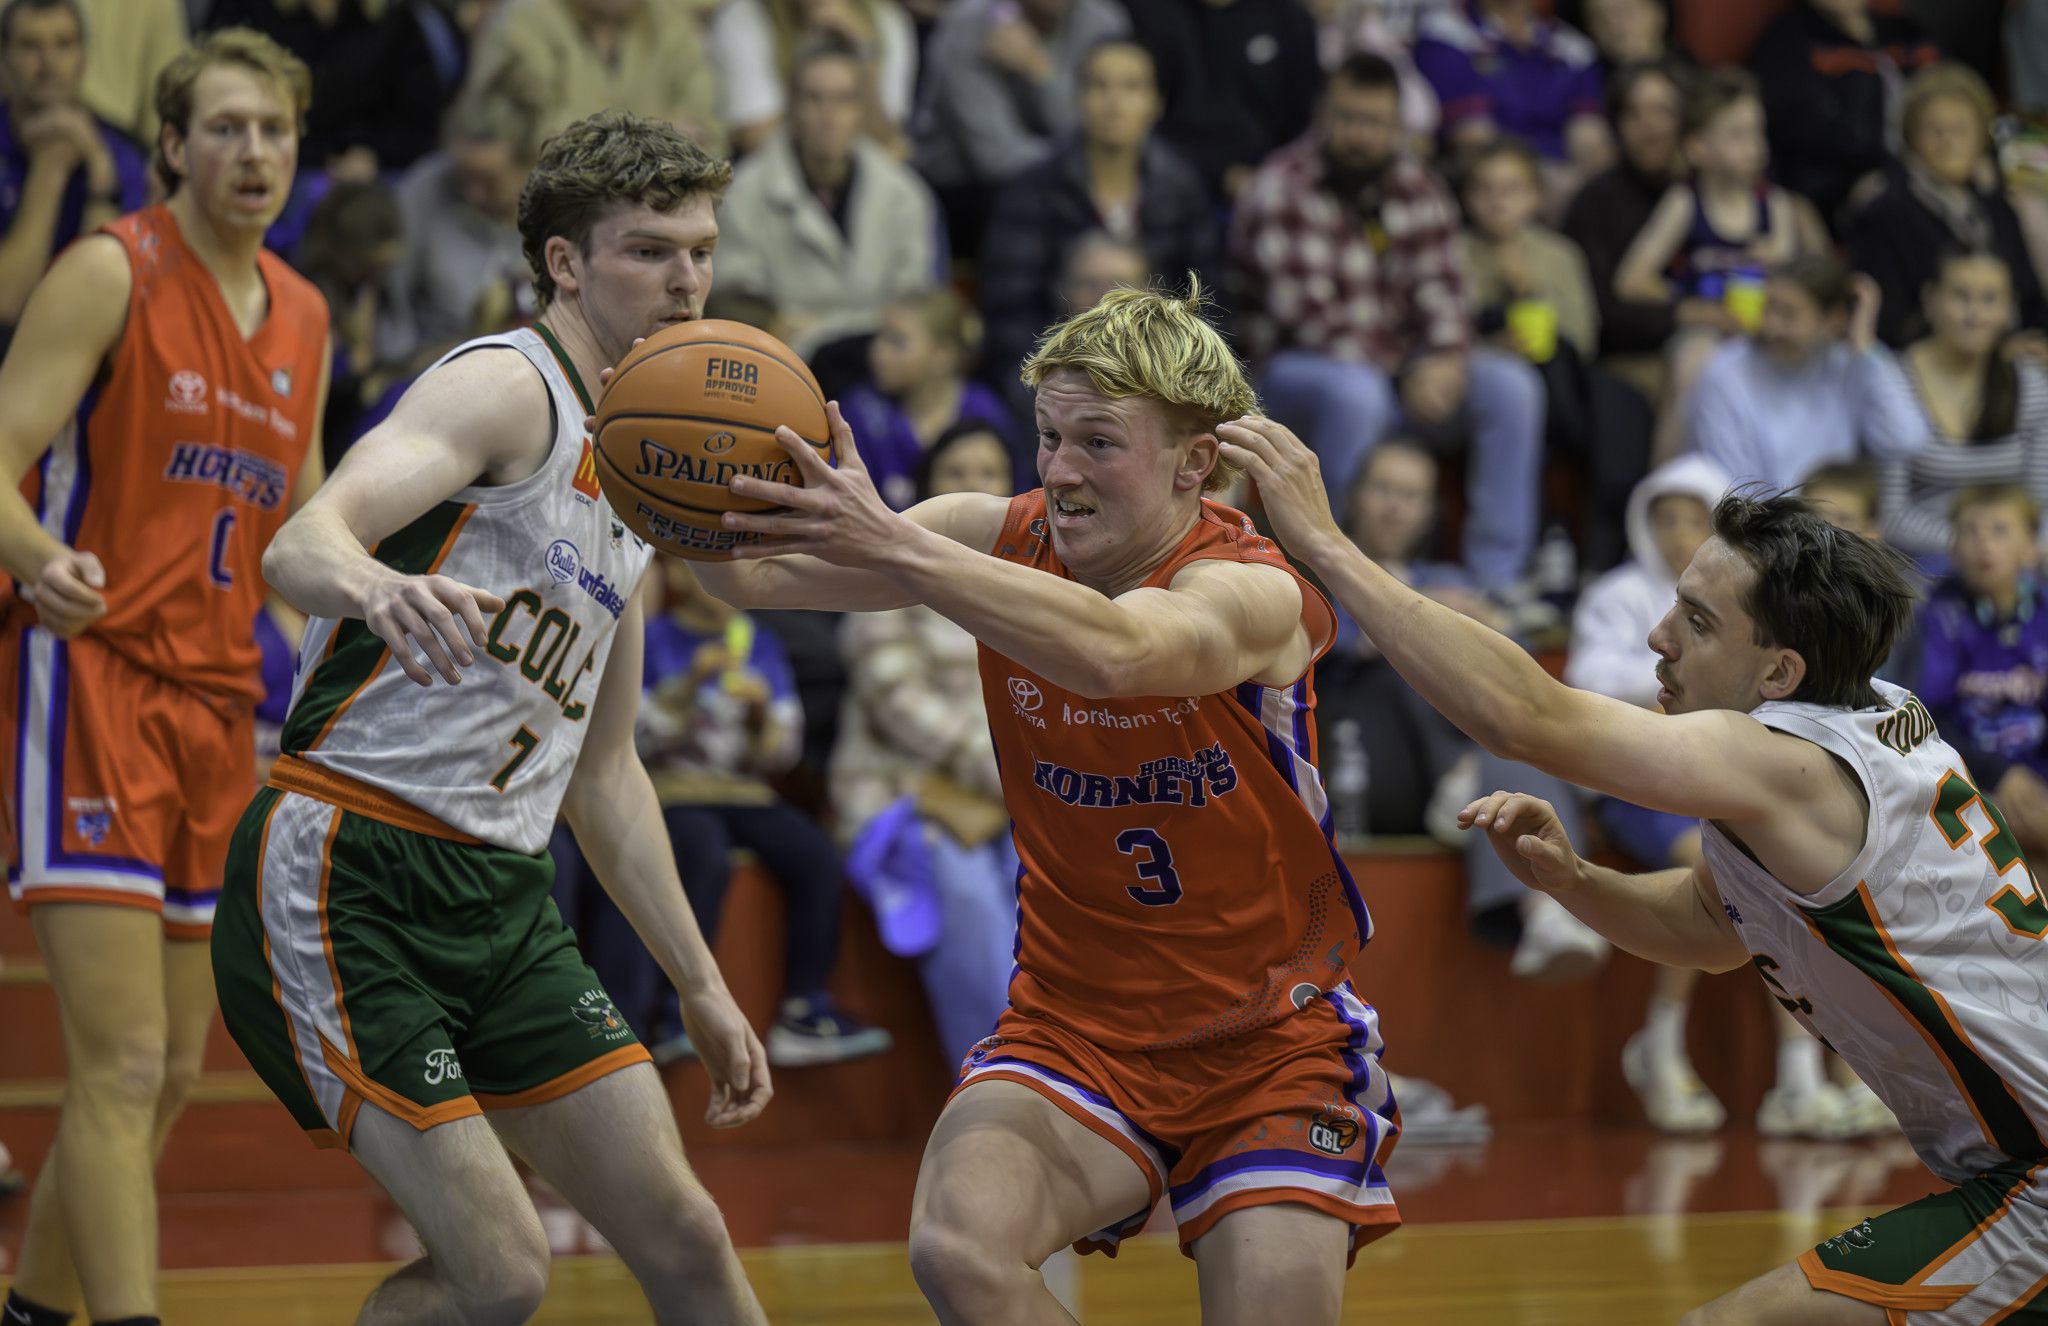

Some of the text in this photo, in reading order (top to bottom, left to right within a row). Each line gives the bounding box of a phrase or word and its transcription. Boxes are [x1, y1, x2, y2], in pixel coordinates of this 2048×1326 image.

[704, 379, 758, 396] APPROVED
[706, 357, 759, 385] FIBA
[636, 502, 772, 543] PRECISIO
[550, 544, 576, 577] Bulla
[489, 723, 541, 794] 7
[1138, 740, 1224, 780] HORSHAM
[1114, 827, 1184, 907] 3
[423, 1047, 463, 1086] For
[1311, 1124, 1343, 1153] CBL
